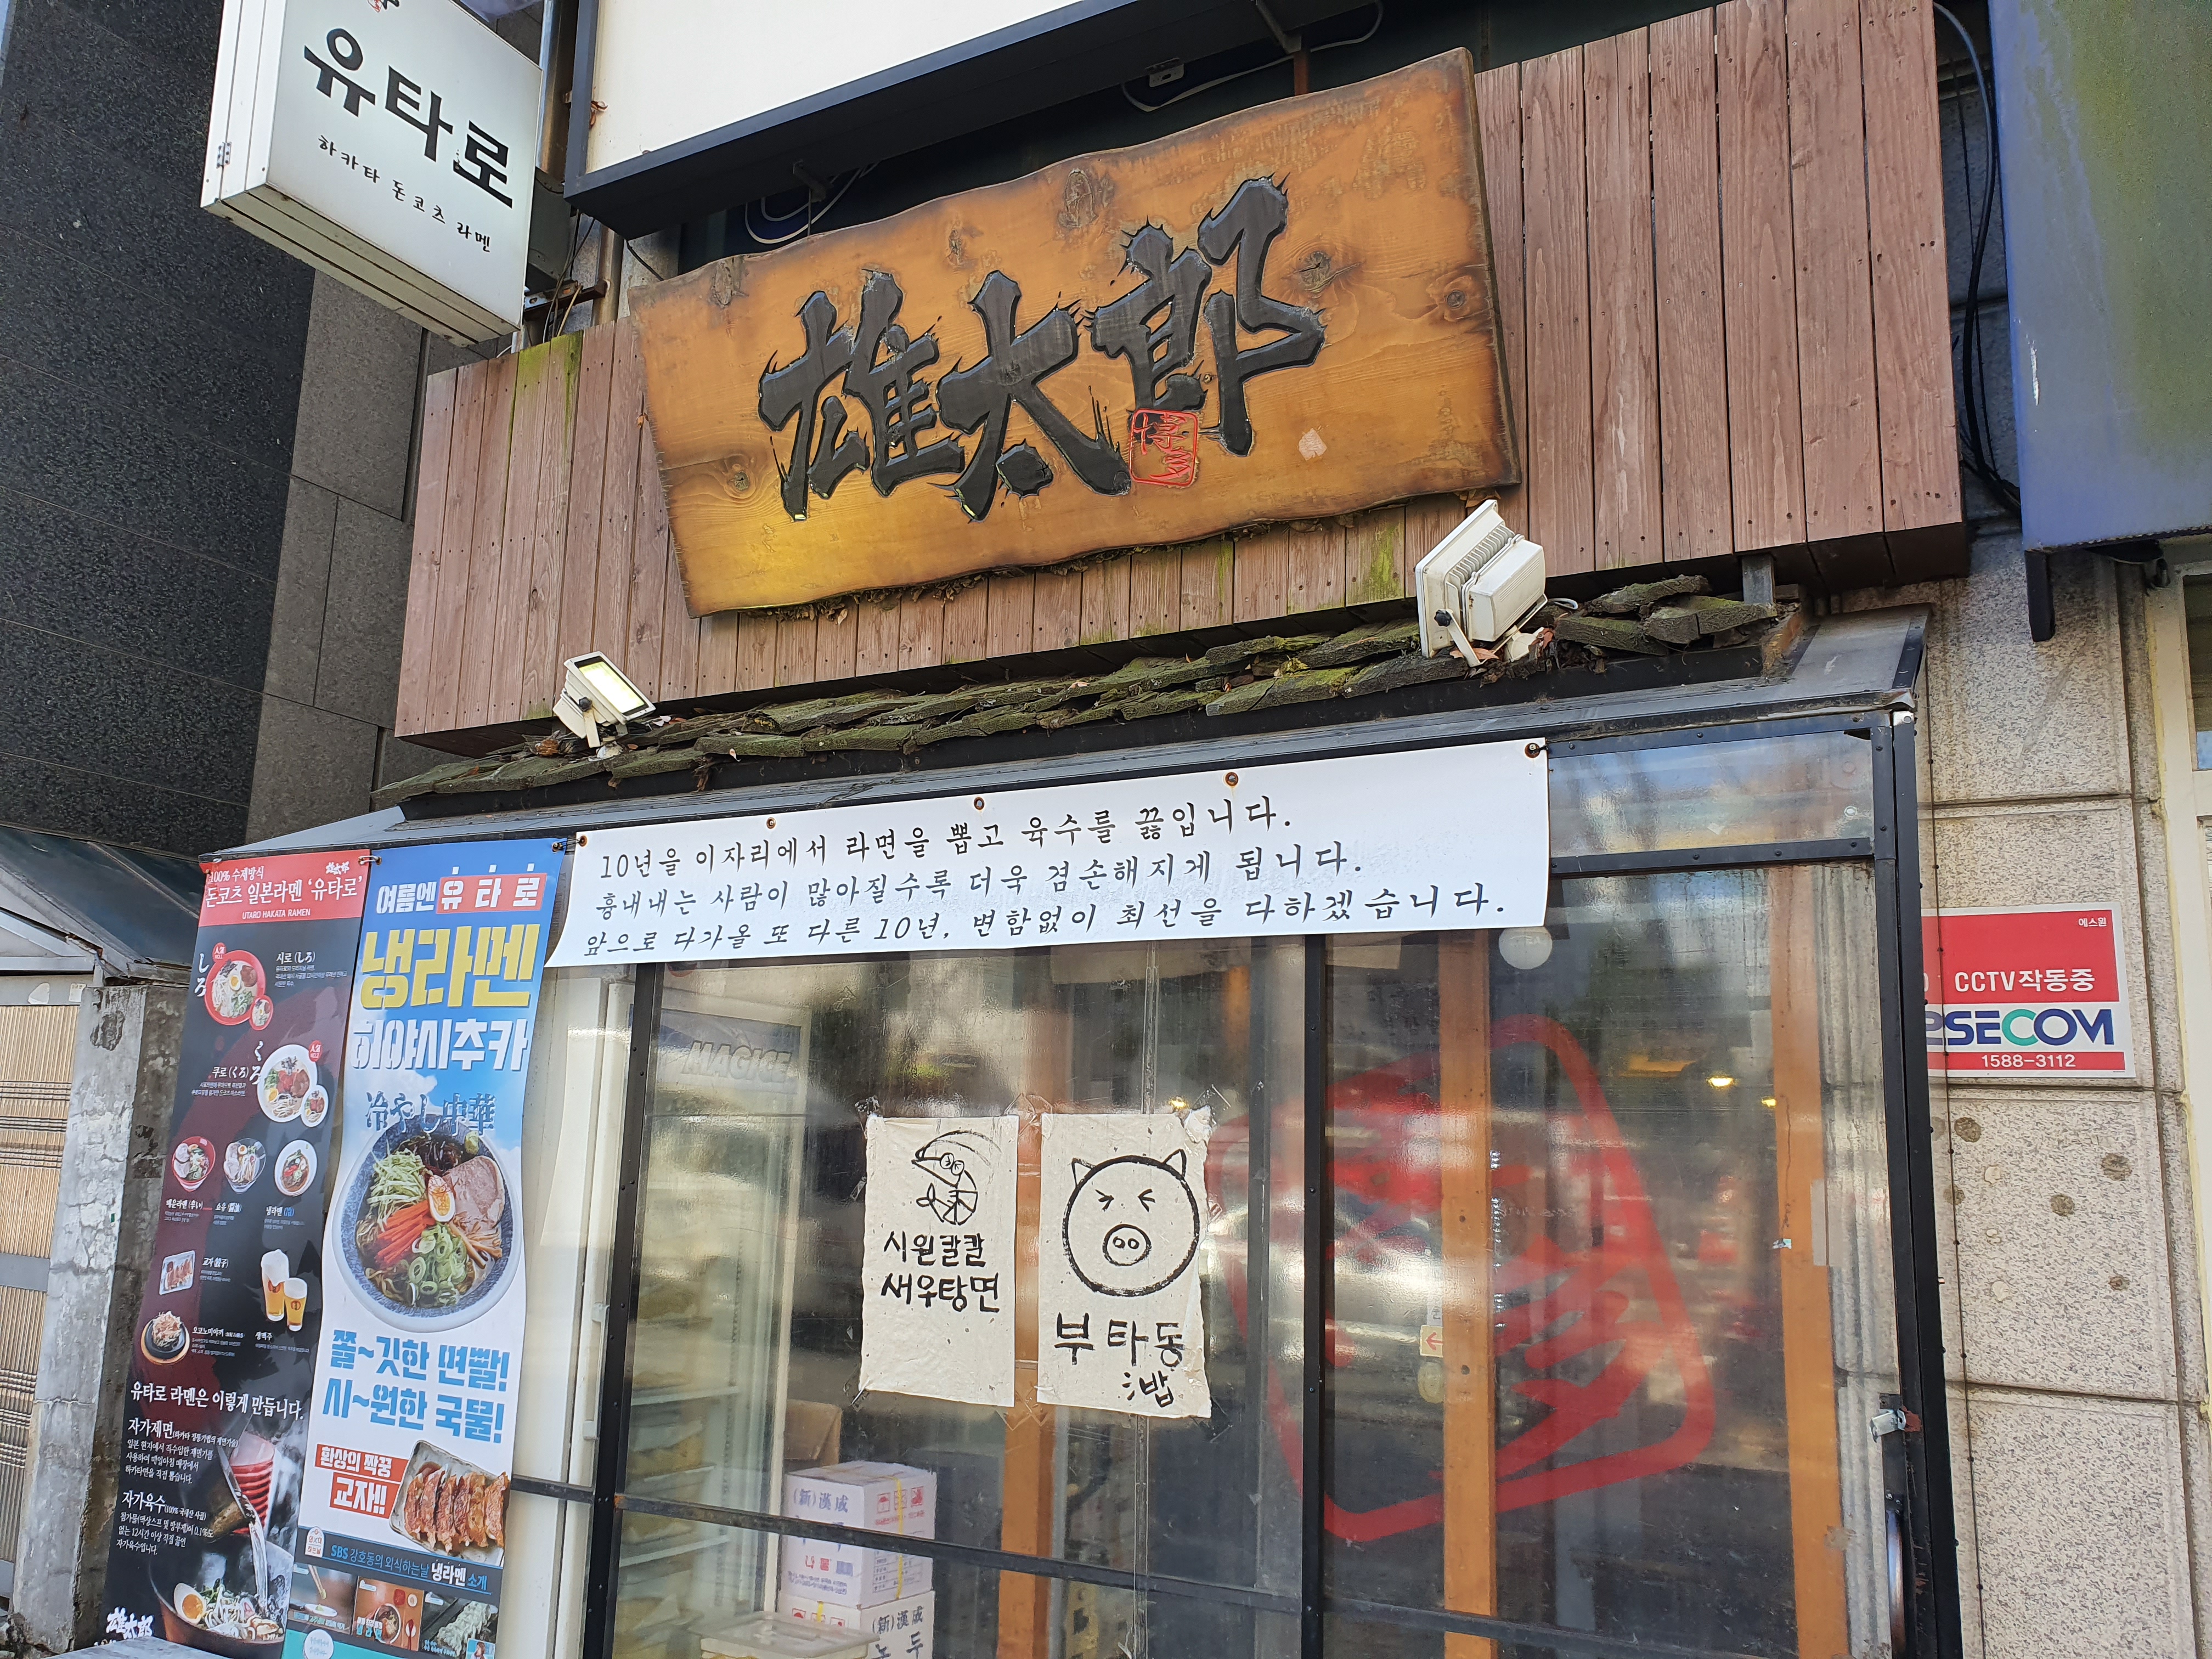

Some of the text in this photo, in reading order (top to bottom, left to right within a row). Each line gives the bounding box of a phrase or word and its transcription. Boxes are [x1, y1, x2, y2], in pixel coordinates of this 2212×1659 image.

[303, 29, 512, 208] 유타로
[318, 135, 490, 252] 하카타 돈코츠 라멘
[600, 795, 1291, 879] 10년을 이자리에서 라면을 뽑고 육수를 끓입니다.
[210, 866, 264, 883] 100% 수제방식
[596, 840, 1362, 922] 흉내내는 사람이 많아질수록 더욱 겸손해지게 됩니다.
[206, 885, 242, 908] 돈코츠
[248, 879, 302, 905] 일본라멘
[376, 877, 540, 914] 여름엔 유타로
[242, 908, 311, 919] UTARO HAKATA RAMEN
[584, 882, 1504, 958] 앞으로 다가올 또 다른 10년, 변함없이 최선을 다하겠습니다.
[2078, 917, 2107, 928] 에스원
[276, 952, 293, 964] 시로
[360, 924, 540, 1008] 냉라멘
[1955, 969, 2095, 992] CCTV작동중
[1945, 1008, 2114, 1046] SECOM
[351, 1018, 531, 1071] 히야시추카
[1982, 1054, 2076, 1068] 1588-3112
[212, 1066, 228, 1079] 쿠로
[884, 1231, 986, 1267] 시원칼칼
[881, 1272, 1000, 1313] 새우탕면
[255, 1331, 273, 1341] 생맥주
[1054, 1312, 1184, 1368] 부타동
[330, 1329, 510, 1392] 쫄~깃한 면빨!
[131, 1381, 304, 1421] 유타로 라멘은 이렇게 만듭니다.
[322, 1378, 505, 1443] 시~원한 국물!
[127, 1417, 173, 1440] 자가제면
[126, 1452, 150, 1464] 사용하여
[127, 1439, 214, 1461] 일본 현지에서 직수입한 제면기를
[320, 1446, 392, 1479] 환상의 짝꿍
[125, 1464, 155, 1479] 하카타면을
[156, 1469, 168, 1480] 직접
[121, 1490, 166, 1514] 자가육수
[179, 1508, 194, 1519] 국내산
[334, 1477, 387, 1515] 교자!!
[119, 1525, 131, 1537] 없는
[131, 1527, 150, 1540] 12시간
[150, 1531, 162, 1543] 이상
[163, 1533, 174, 1545] 직접
[163, 1520, 169, 1530] 및
[116, 1538, 157, 1555] 자가육수입니다.
[331, 1544, 488, 1591] SBS 강호동의 외식하는날 냉라멘 소개
